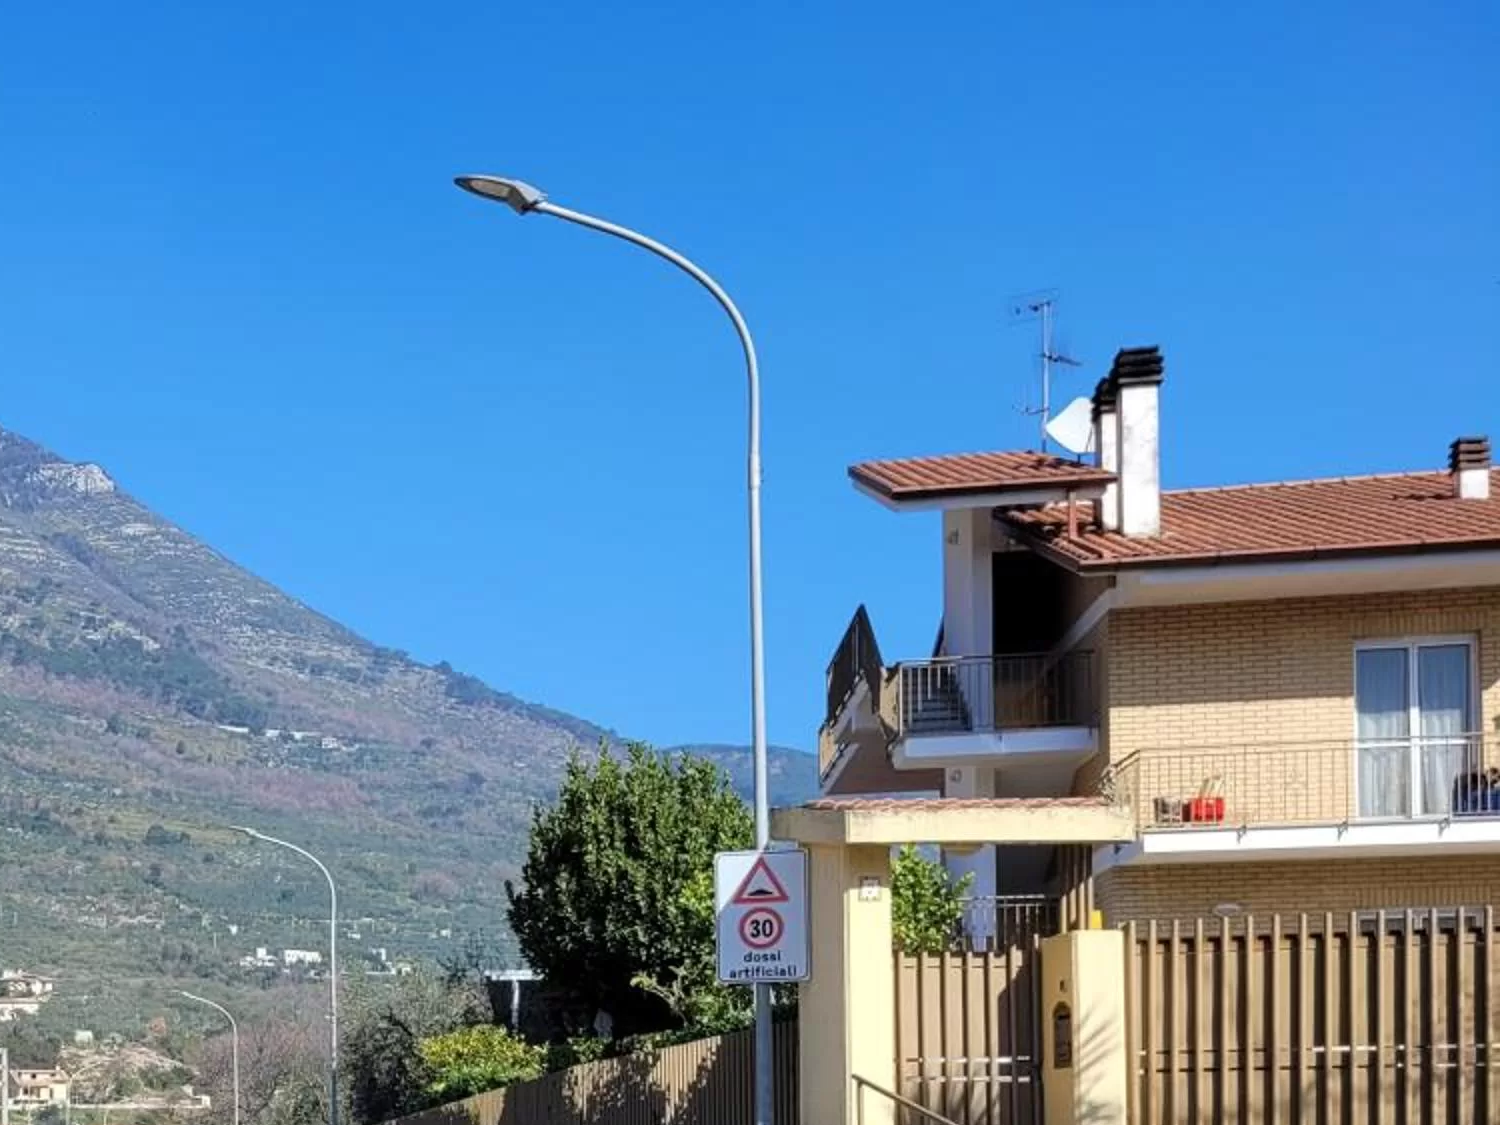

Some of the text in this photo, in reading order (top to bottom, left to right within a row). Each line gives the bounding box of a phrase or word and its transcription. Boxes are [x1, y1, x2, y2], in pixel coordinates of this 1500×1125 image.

[750, 918, 774, 938] 30
[743, 950, 781, 963] dossi
[729, 964, 798, 979] artificiali
